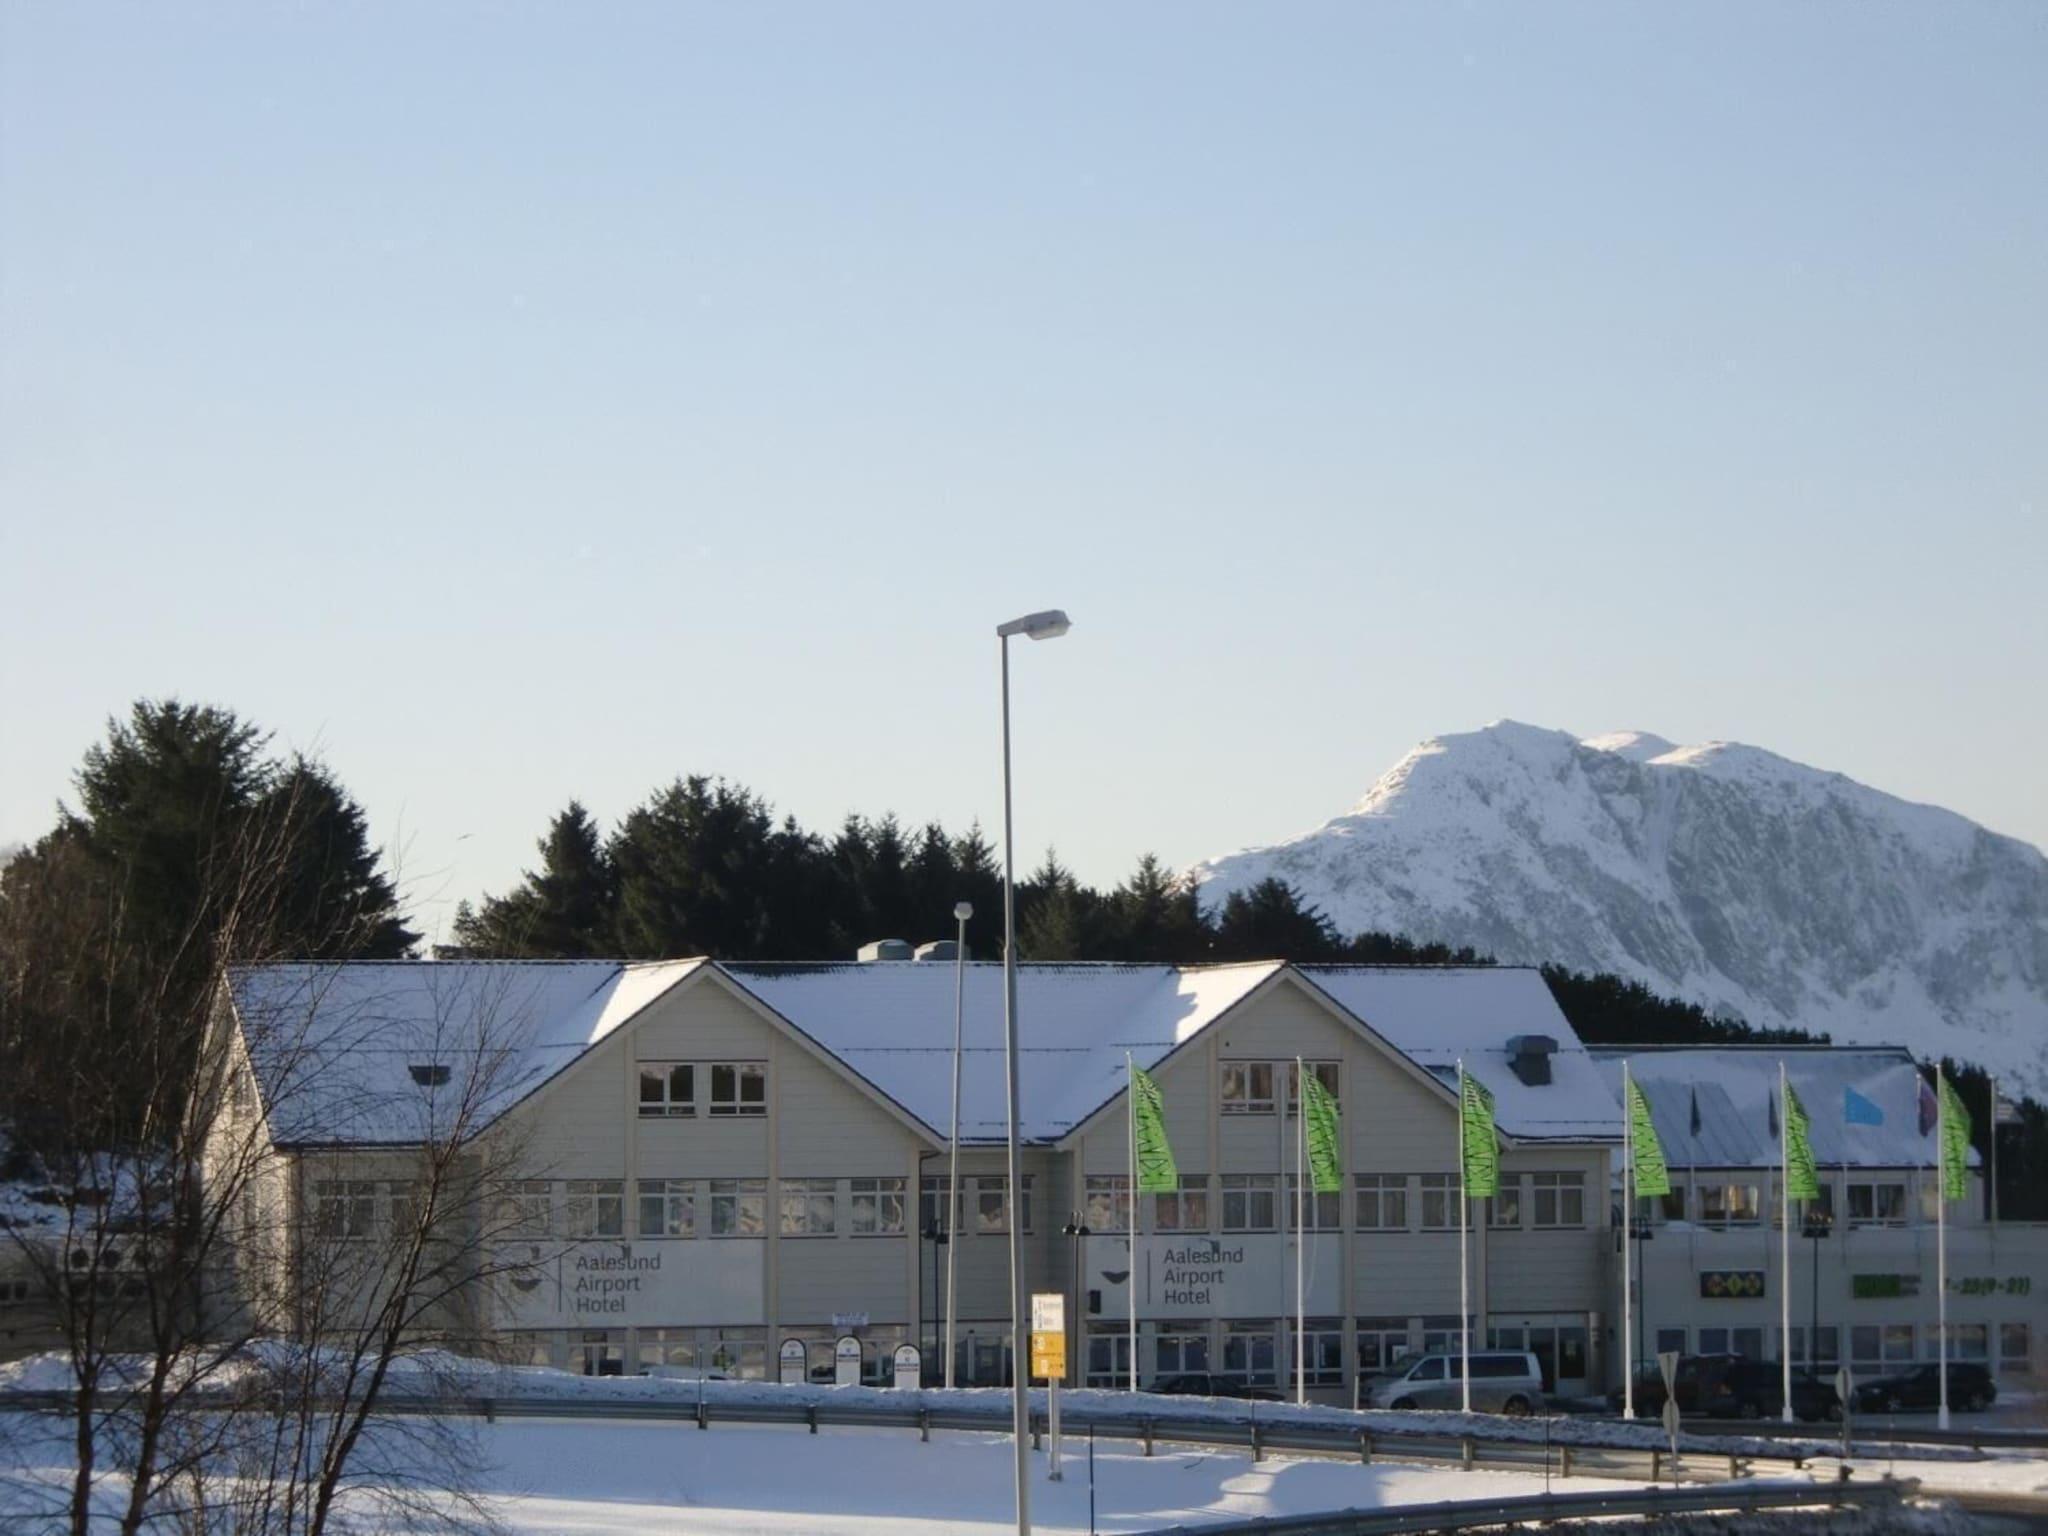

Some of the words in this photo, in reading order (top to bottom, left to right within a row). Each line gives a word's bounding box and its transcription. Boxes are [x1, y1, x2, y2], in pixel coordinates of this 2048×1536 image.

[576, 1251, 661, 1271] Aalesund
[1163, 1247, 1244, 1264] Aalesund
[576, 1274, 641, 1295] Airport
[1164, 1267, 1225, 1288] Airport
[577, 1296, 626, 1313] Hotel
[1164, 1287, 1210, 1305] Hotel
